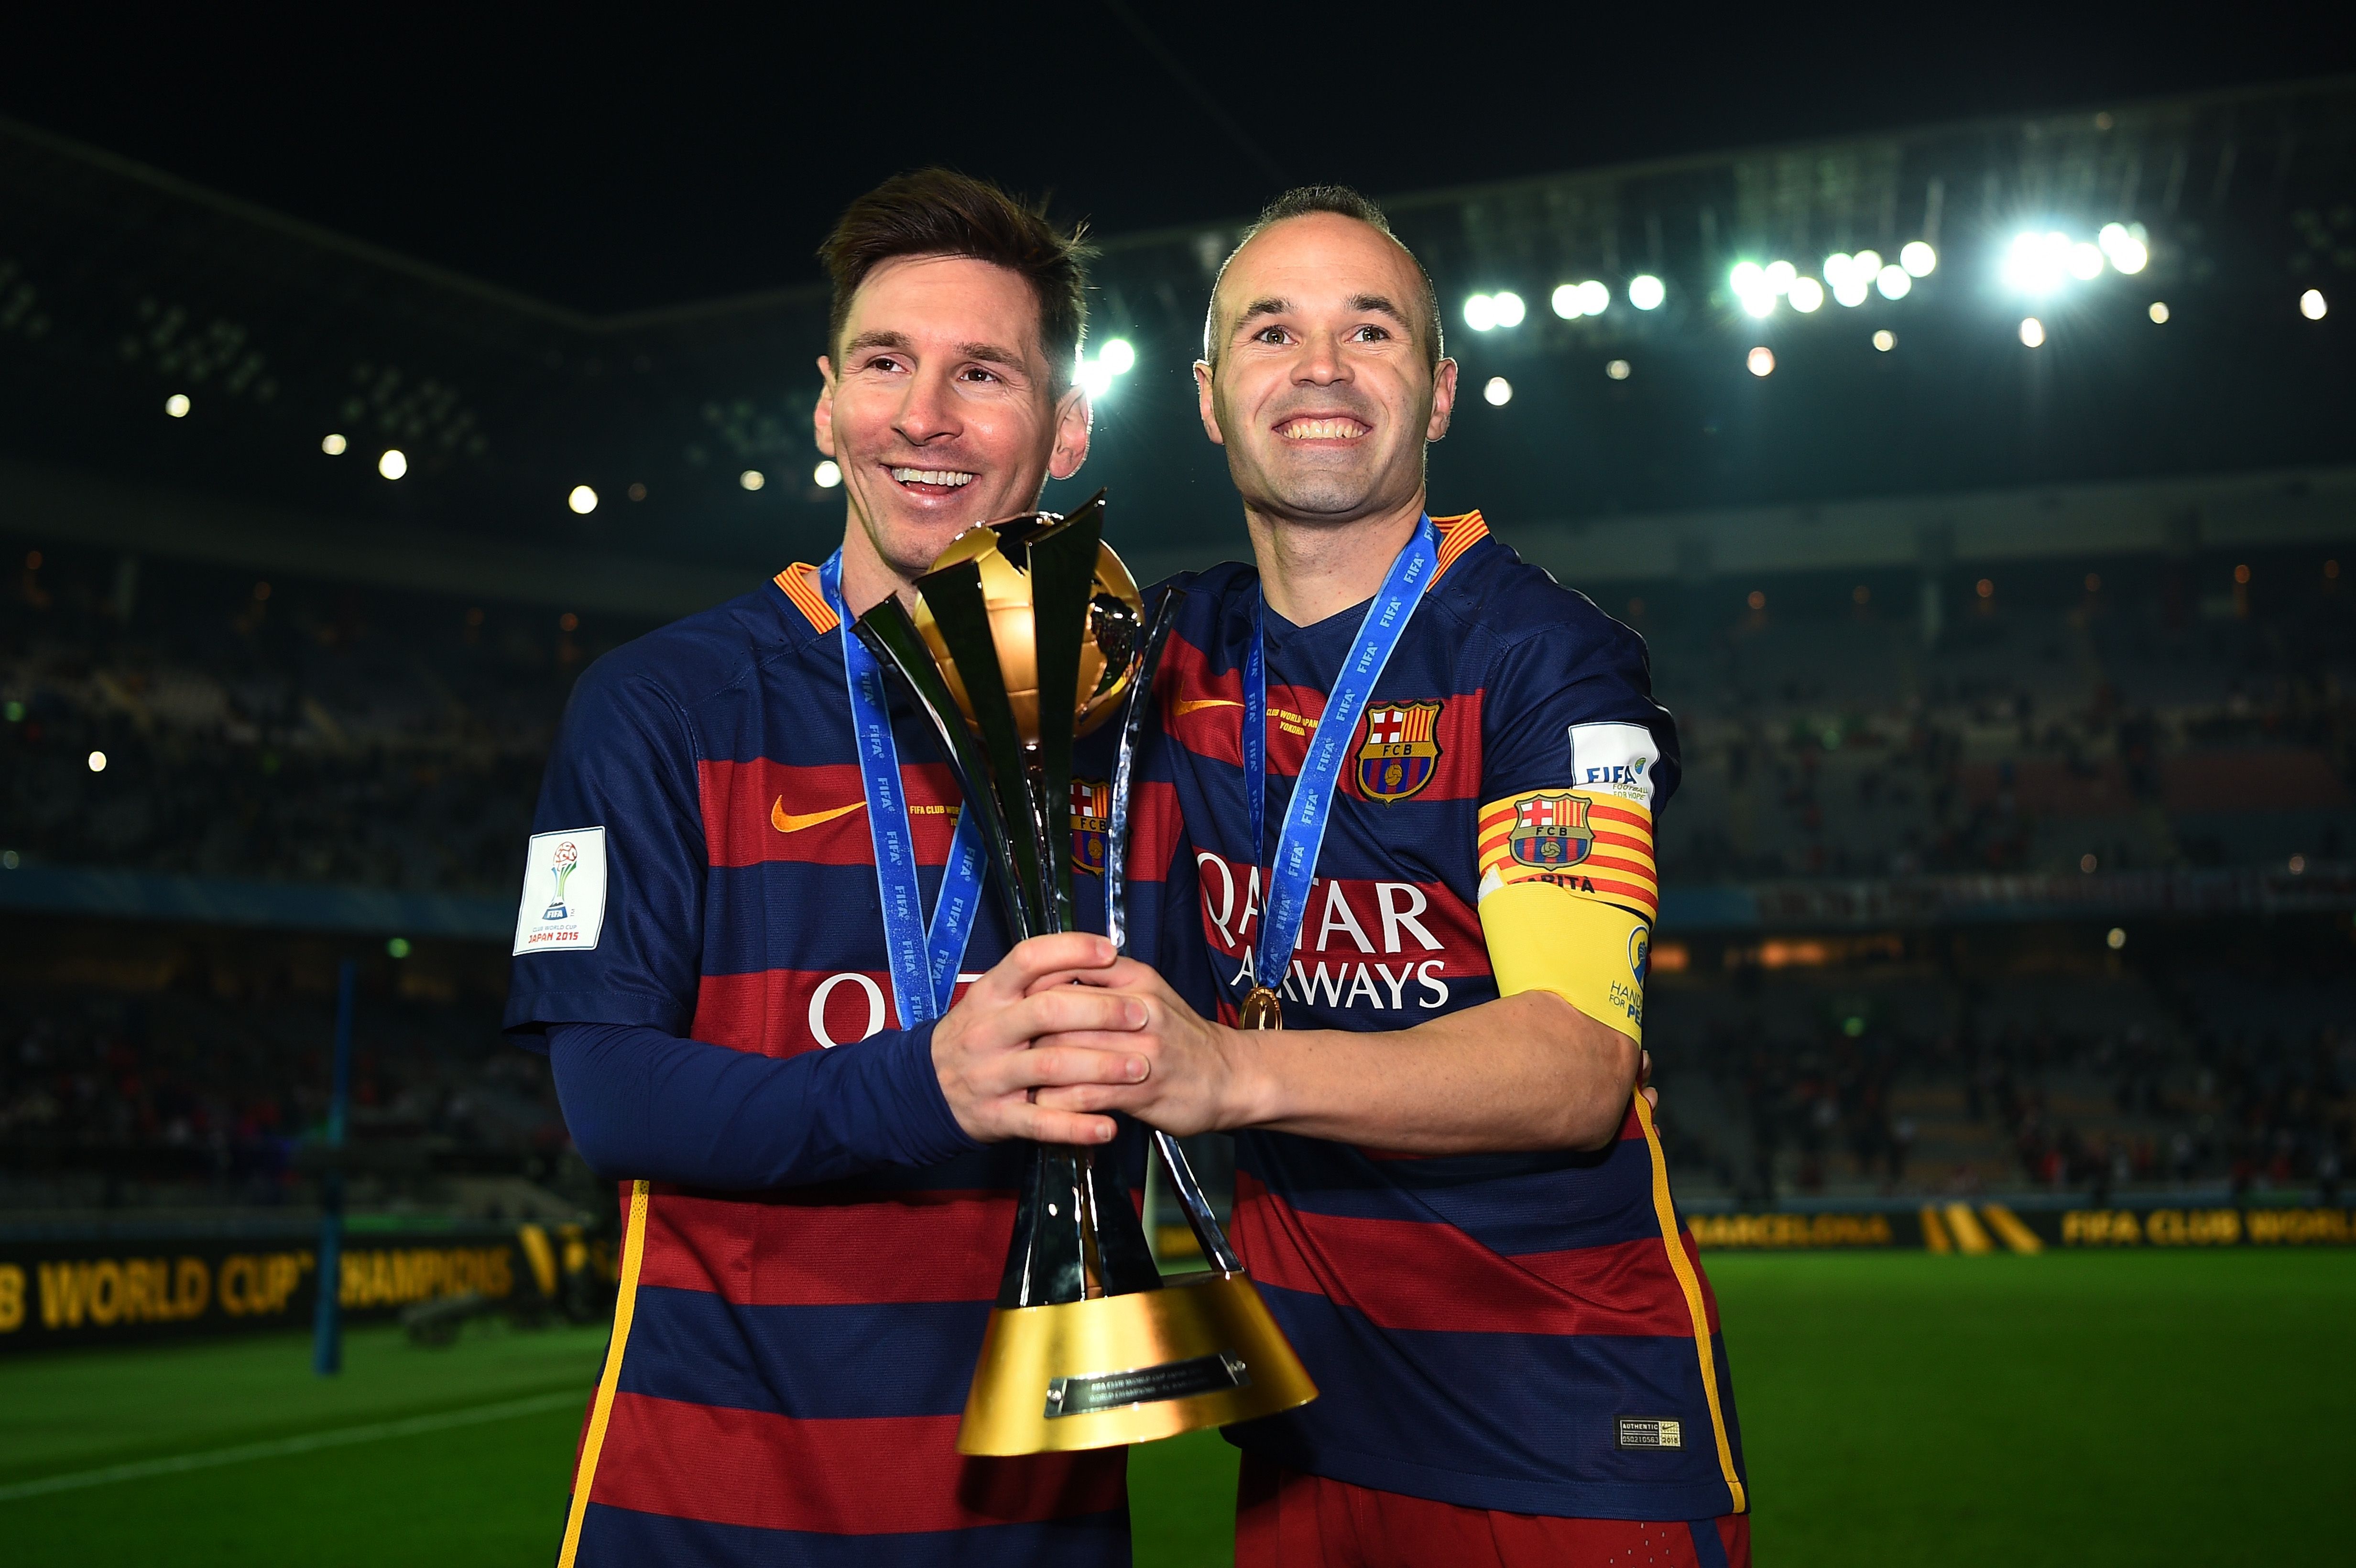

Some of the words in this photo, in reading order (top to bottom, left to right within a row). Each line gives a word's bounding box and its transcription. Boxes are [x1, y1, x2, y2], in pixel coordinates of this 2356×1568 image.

[1280, 710, 1301, 723] WORLD
[1383, 744, 1412, 756] FCB
[1587, 765, 1637, 784] FIFA
[1613, 784, 1648, 794] FOOTBALL
[1628, 792, 1646, 800] HOPE
[910, 806, 925, 814] FIFA
[926, 805, 945, 814] CLUB
[1536, 827, 1568, 836] FCB
[1512, 875, 1595, 893] PITÀ
[1197, 852, 1445, 954] QAAR
[546, 910, 564, 918] FIFA
[528, 932, 554, 944] JAPAN
[556, 932, 579, 941] 2015
[1230, 945, 1449, 1010] ARWAYS
[1611, 980, 1641, 1008] HAND
[1609, 994, 1625, 1009] FOR
[2061, 1209, 2143, 1246] FIFA
[2145, 1208, 2242, 1246] CLUB
[2246, 1207, 2356, 1245] WORL
[37, 1254, 212, 1330] WORLD
[337, 1245, 515, 1310] HAMPIONS
